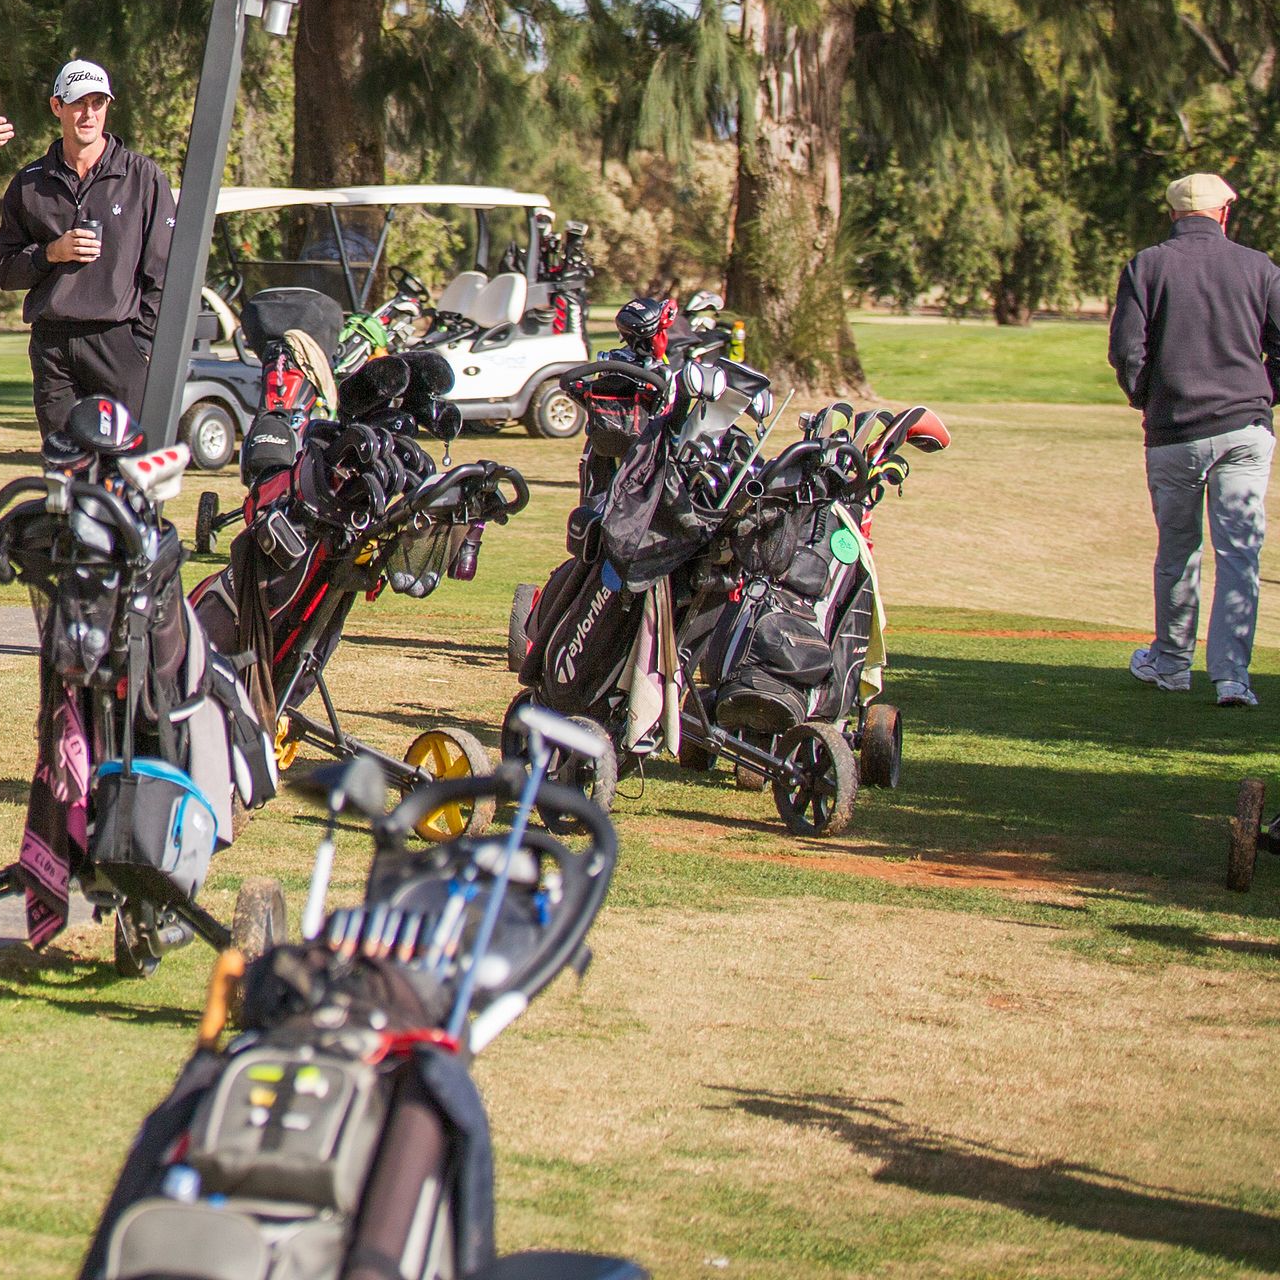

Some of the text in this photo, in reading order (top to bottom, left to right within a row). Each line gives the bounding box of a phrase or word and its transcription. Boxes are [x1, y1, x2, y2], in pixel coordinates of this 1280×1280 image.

[66, 71, 104, 86] Titleist
[395, 420, 402, 430] 3
[251, 434, 289, 447] Titleist
[360, 442, 367, 452] 4
[554, 585, 612, 683] TaylorMa
[34, 853, 56, 877] CLUB
